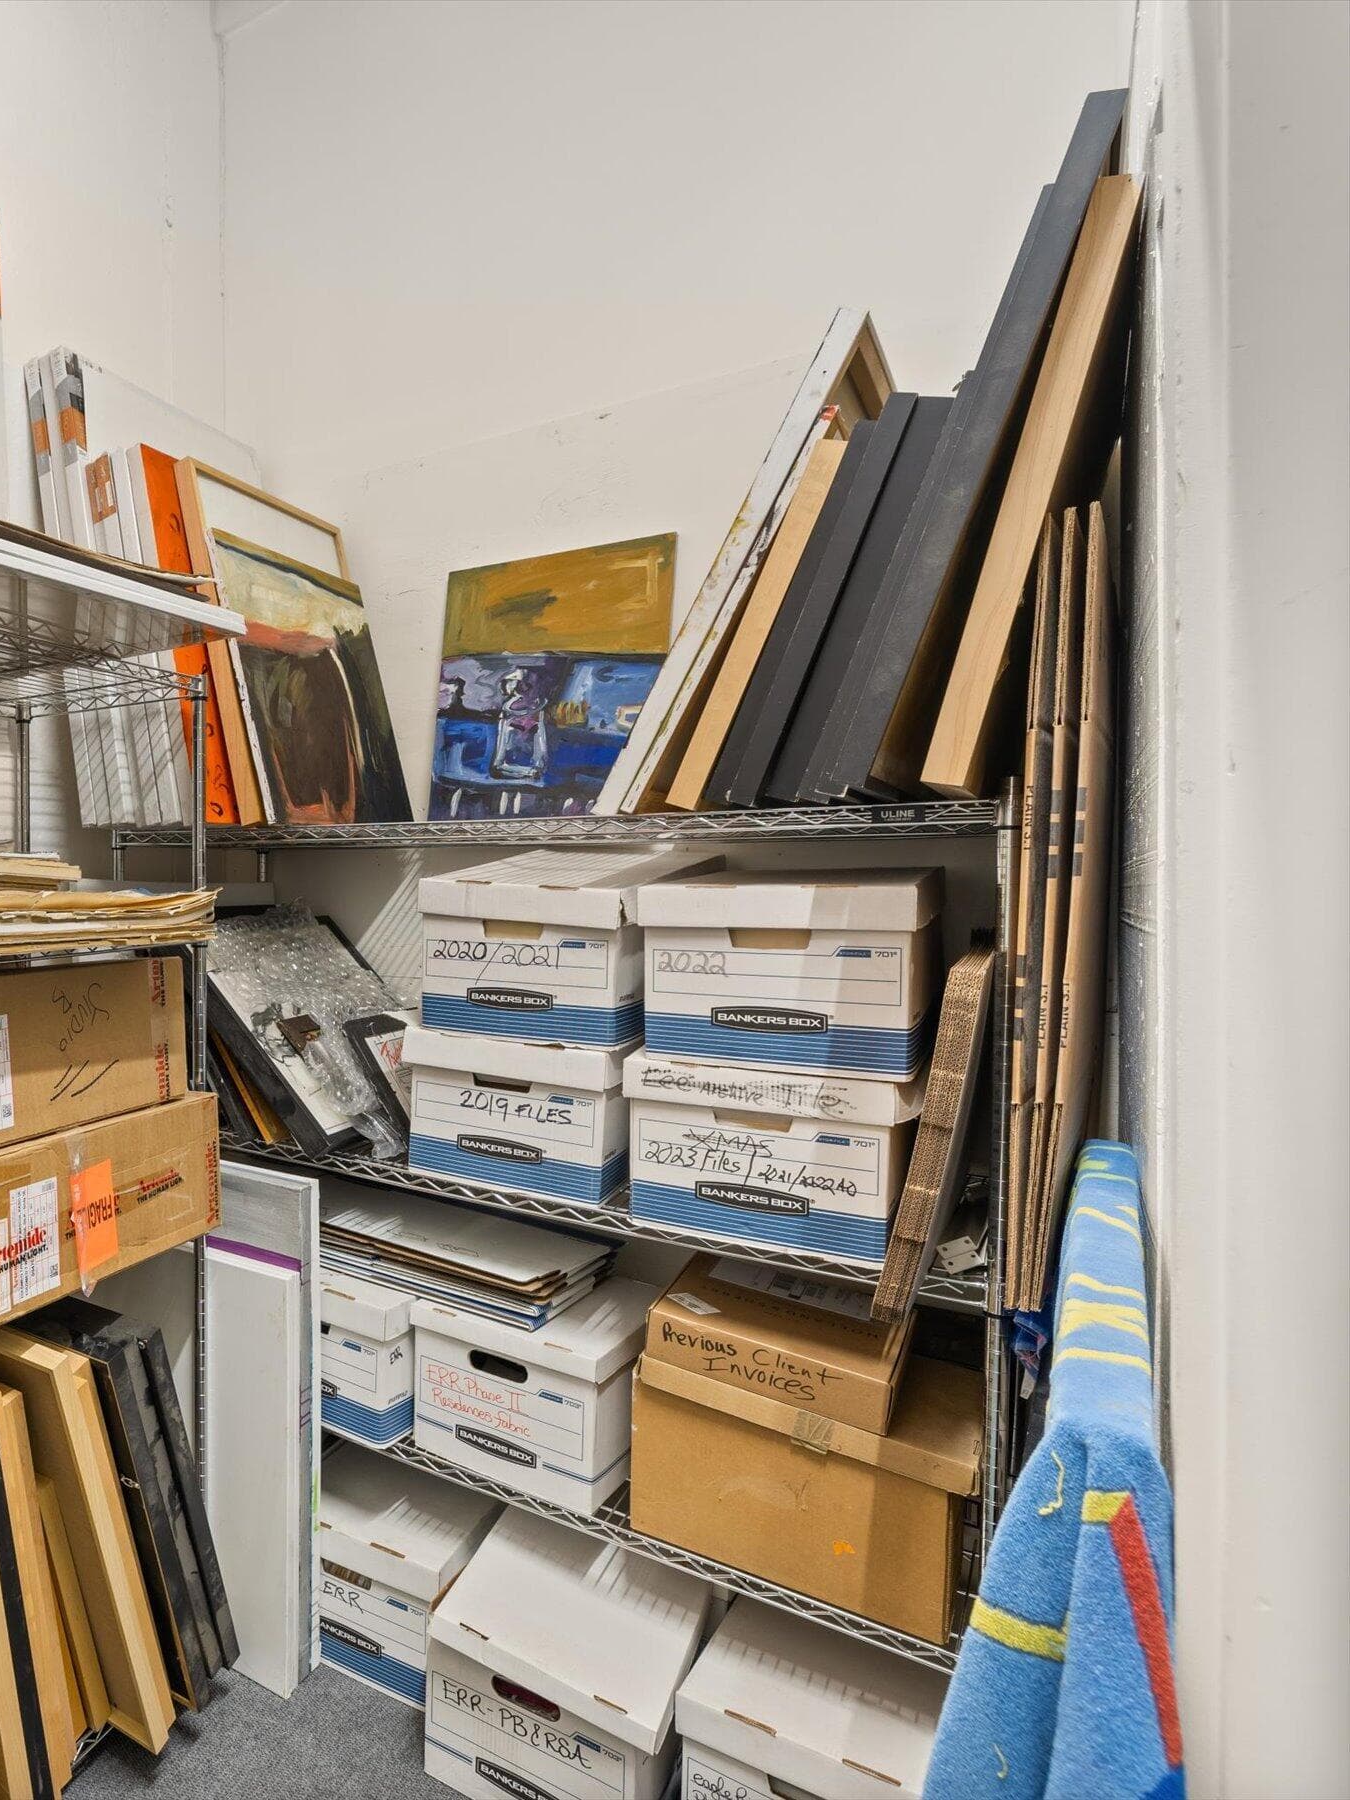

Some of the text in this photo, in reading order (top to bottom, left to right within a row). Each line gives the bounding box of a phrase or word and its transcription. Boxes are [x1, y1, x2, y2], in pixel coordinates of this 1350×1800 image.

[880, 809, 916, 819] ULINE
[657, 951, 729, 978] 2022
[470, 991, 549, 1006] BANKERS BOX
[717, 1012, 822, 1028] BANKERS BOX
[1037, 1007, 1048, 1049] PLAIN
[1060, 1007, 1070, 1048] PLAIN
[459, 1090, 573, 1125] 2019 FILES
[461, 1139, 539, 1160] BANKERS BOX
[644, 1141, 697, 1168] 2023
[700, 1149, 742, 1173] Files
[137, 1195, 148, 1205] THE
[148, 1184, 170, 1200] HUMAN
[700, 1186, 804, 1211] BANKERS BOX
[26, 1243, 49, 1259] LIGHT.
[662, 1321, 843, 1386] Previous Client
[321, 1384, 335, 1394] OX
[425, 1362, 529, 1416] ERR Phase II
[702, 1356, 816, 1401] Invoices
[431, 1386, 493, 1424] Residences
[458, 1429, 533, 1464] BANKERS BOX
[323, 1580, 364, 1614] ERR
[320, 1621, 379, 1654] ANKERS BOX
[480, 1763, 538, 1799] BANKERS
